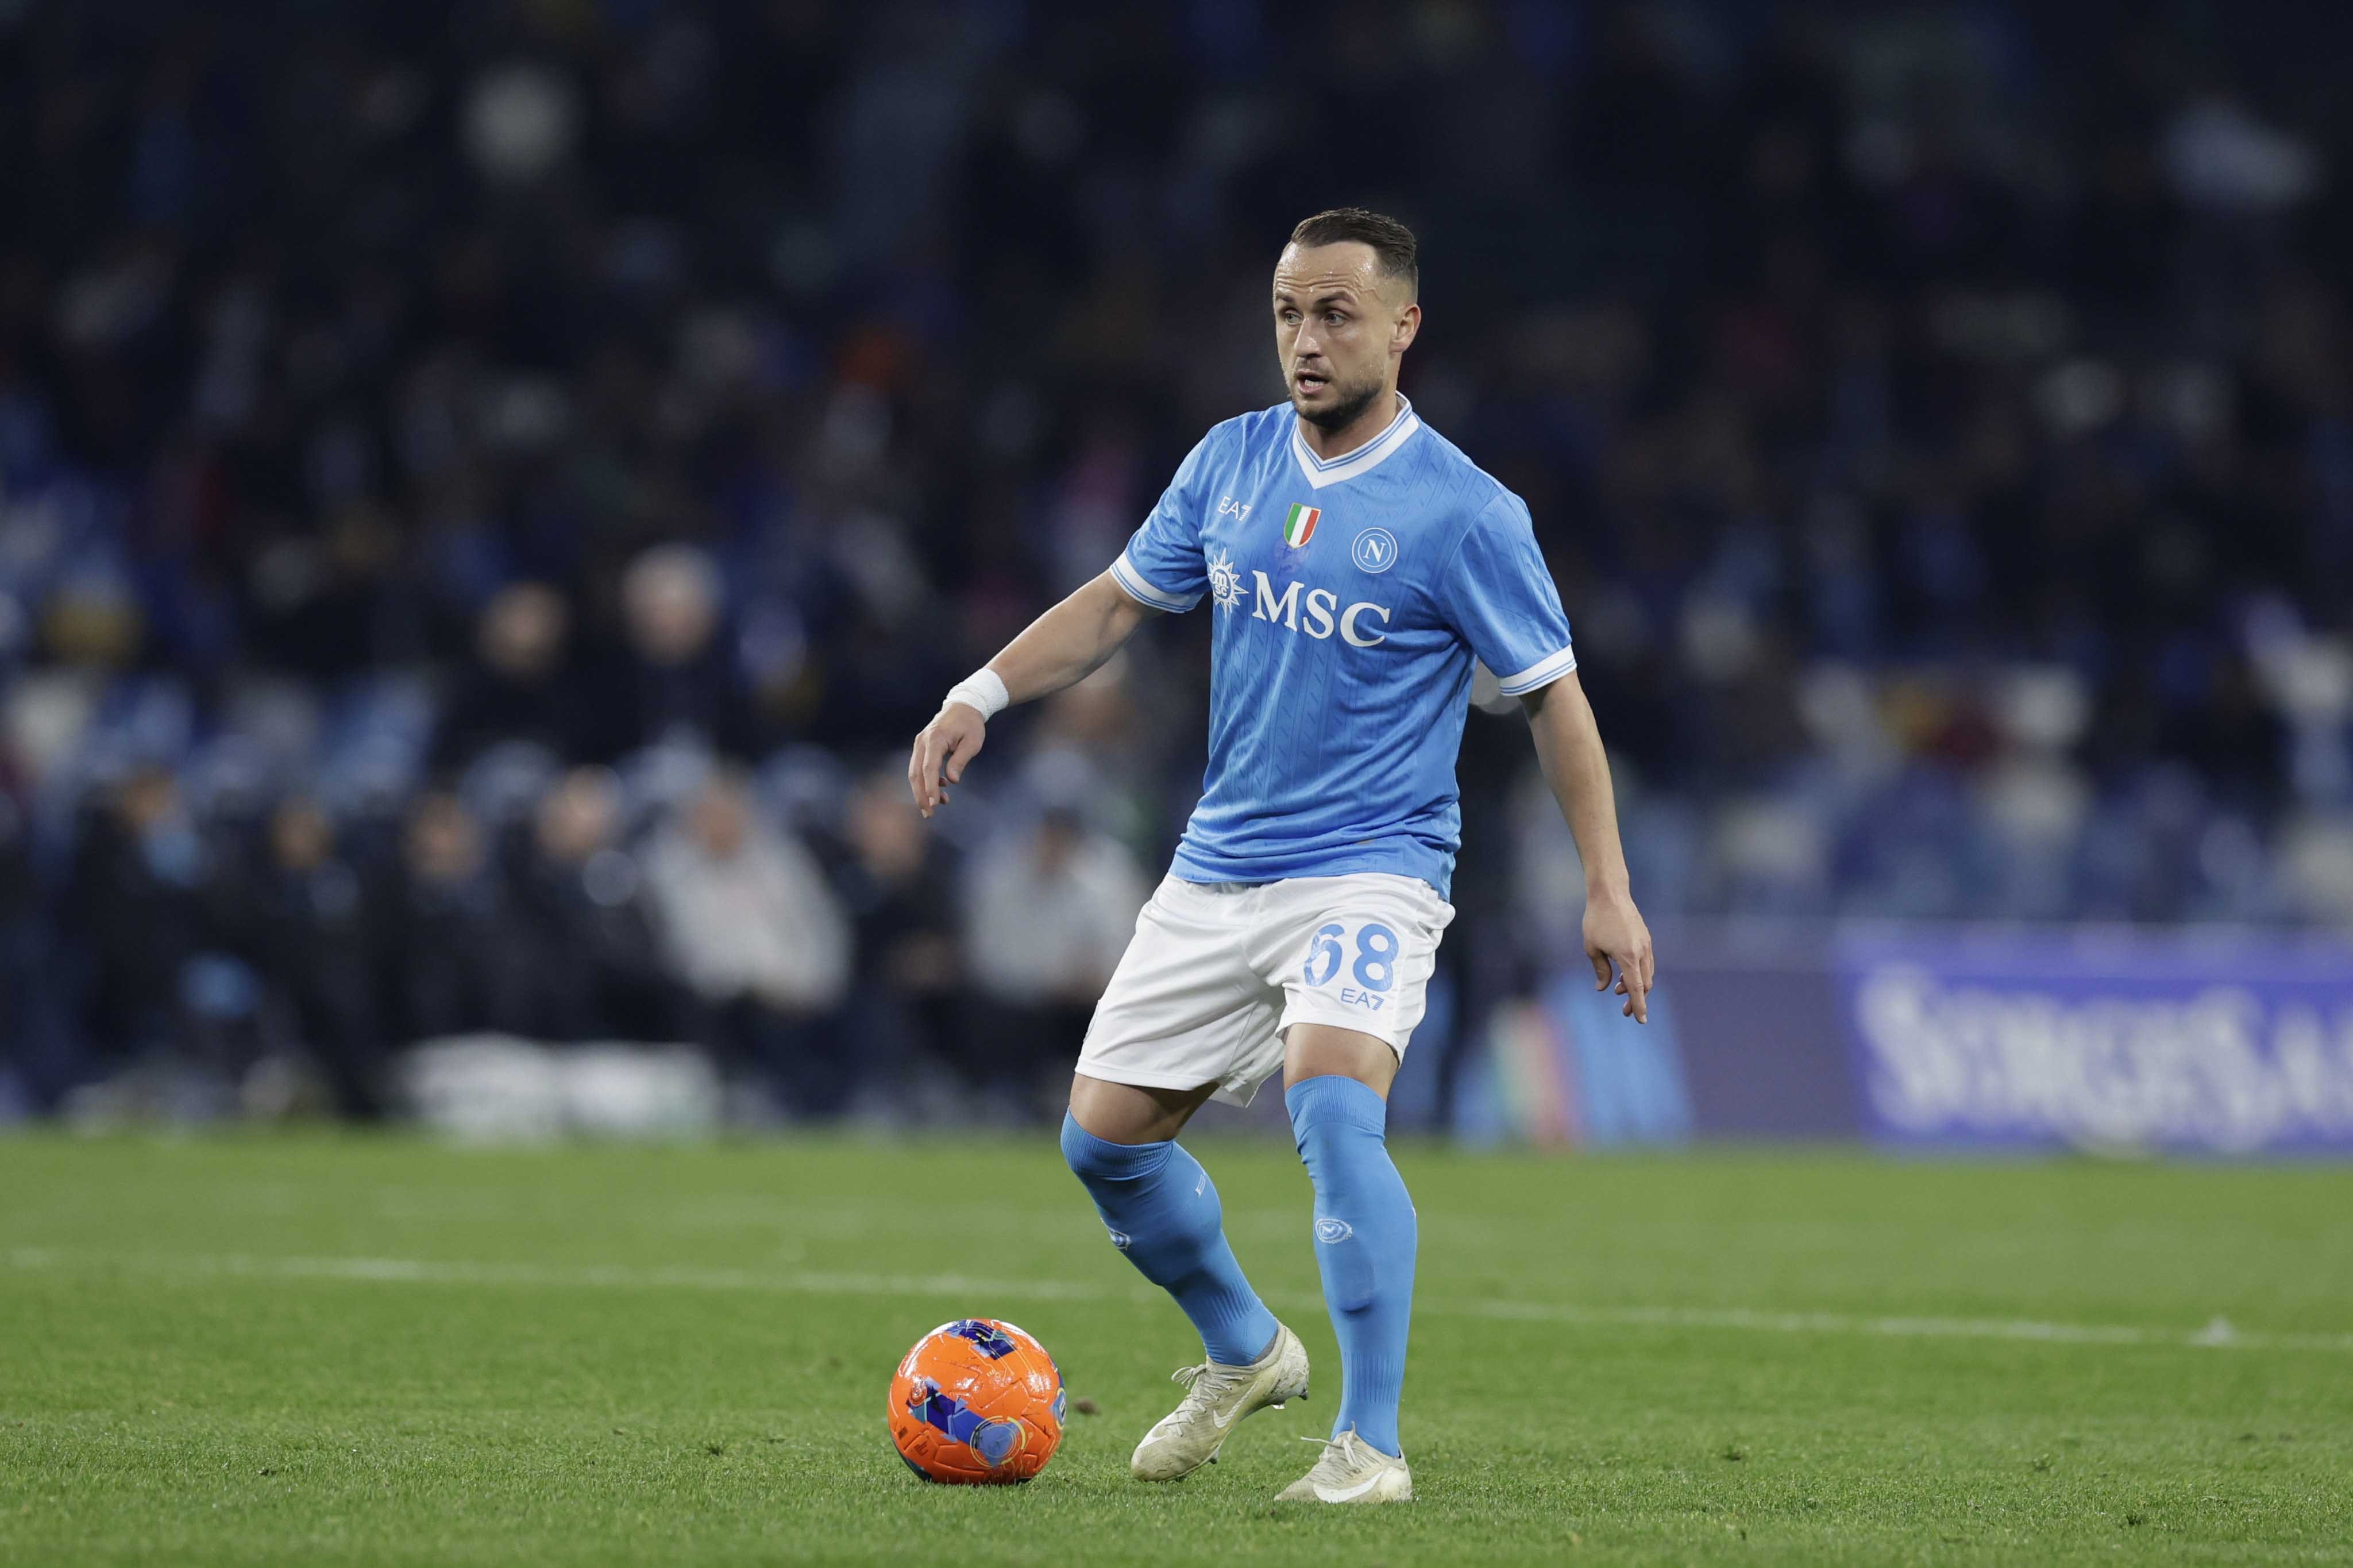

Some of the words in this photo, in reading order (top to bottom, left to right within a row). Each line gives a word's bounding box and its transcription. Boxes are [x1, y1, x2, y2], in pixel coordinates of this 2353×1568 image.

[1217, 496, 1252, 522] EA7
[1362, 538, 1387, 562] N
[1252, 569, 1391, 647] MSC
[1303, 923, 1399, 992] 68
[1341, 987, 1385, 1011] EA7
